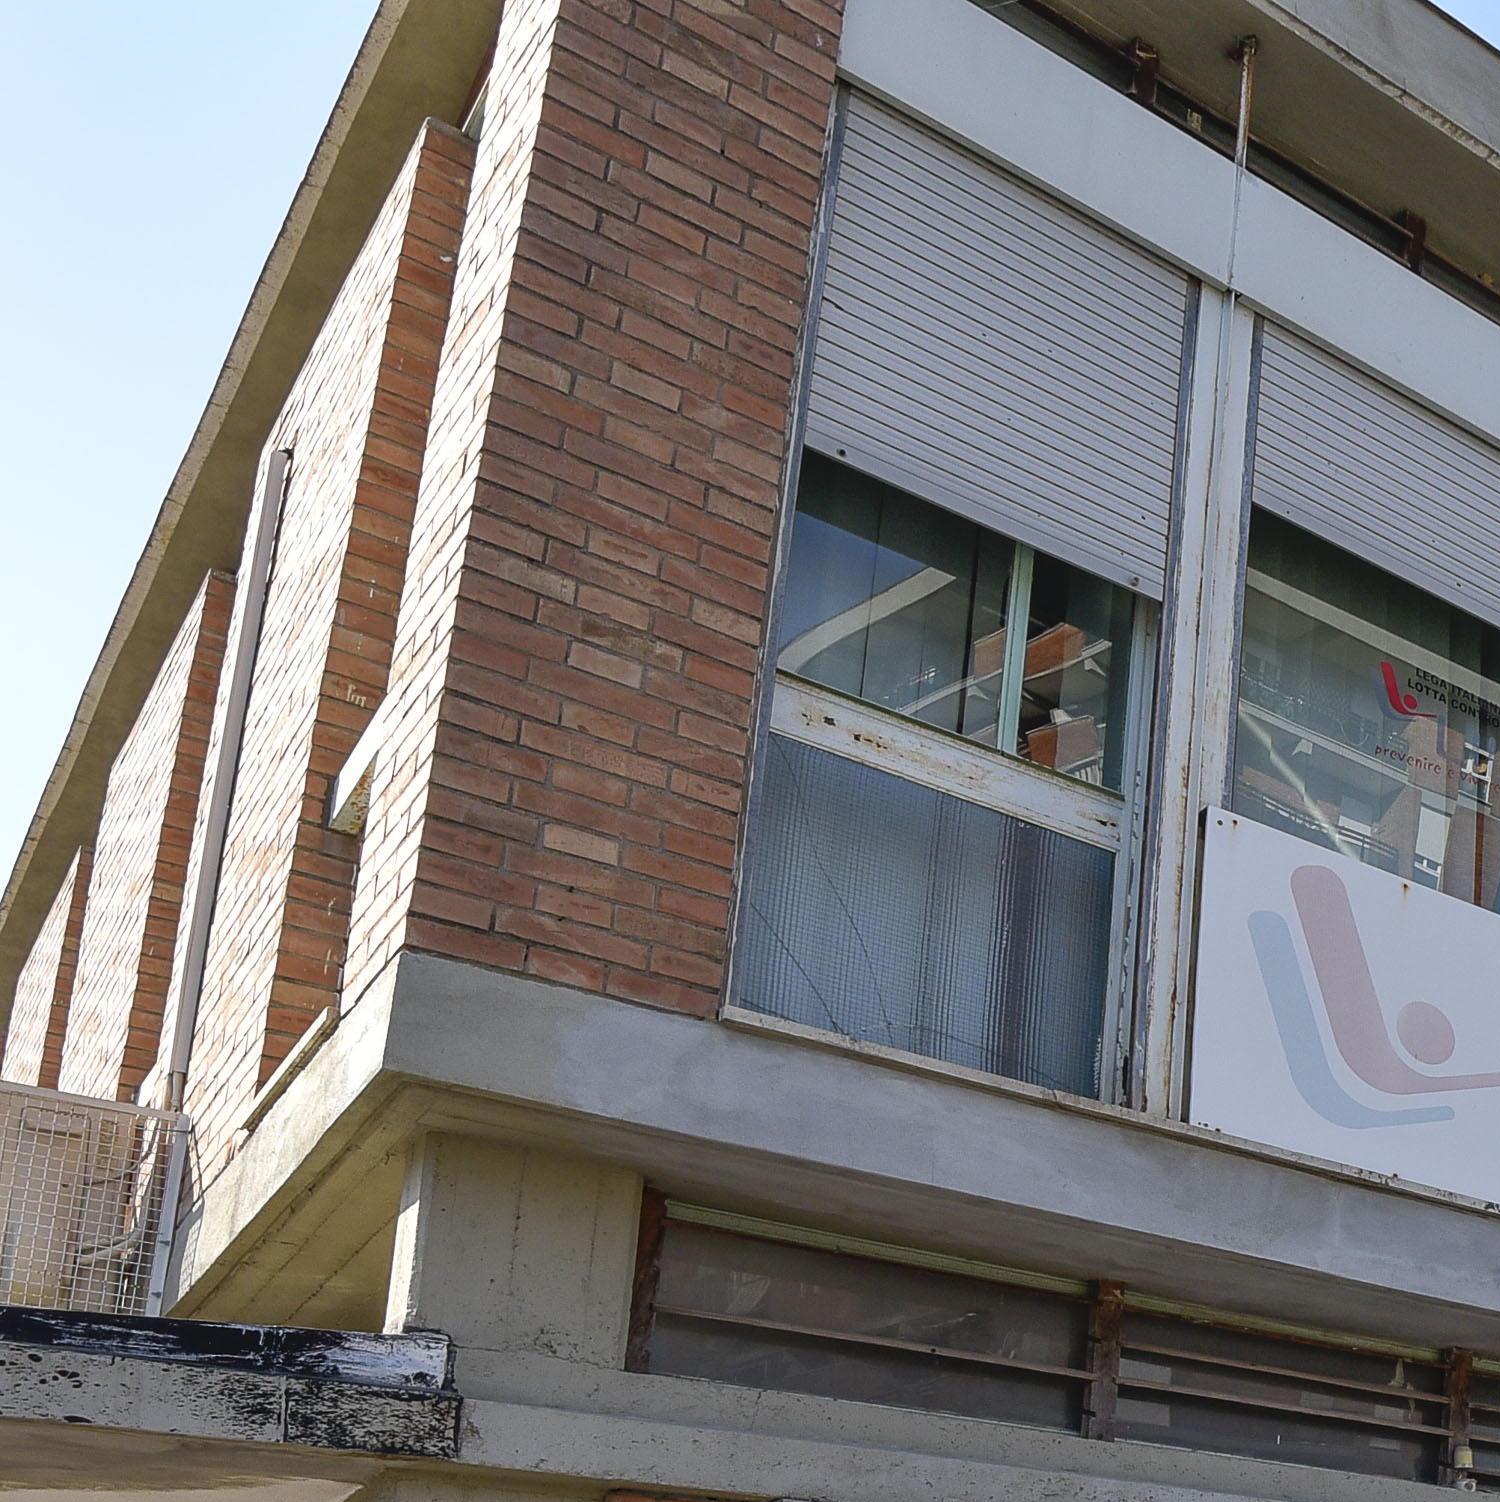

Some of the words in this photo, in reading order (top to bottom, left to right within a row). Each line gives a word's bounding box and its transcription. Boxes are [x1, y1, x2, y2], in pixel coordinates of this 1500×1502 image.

[1408, 678, 1447, 705] LOTTA
[1415, 667, 1447, 689] LEGA
[1375, 744, 1441, 773] prevenire
